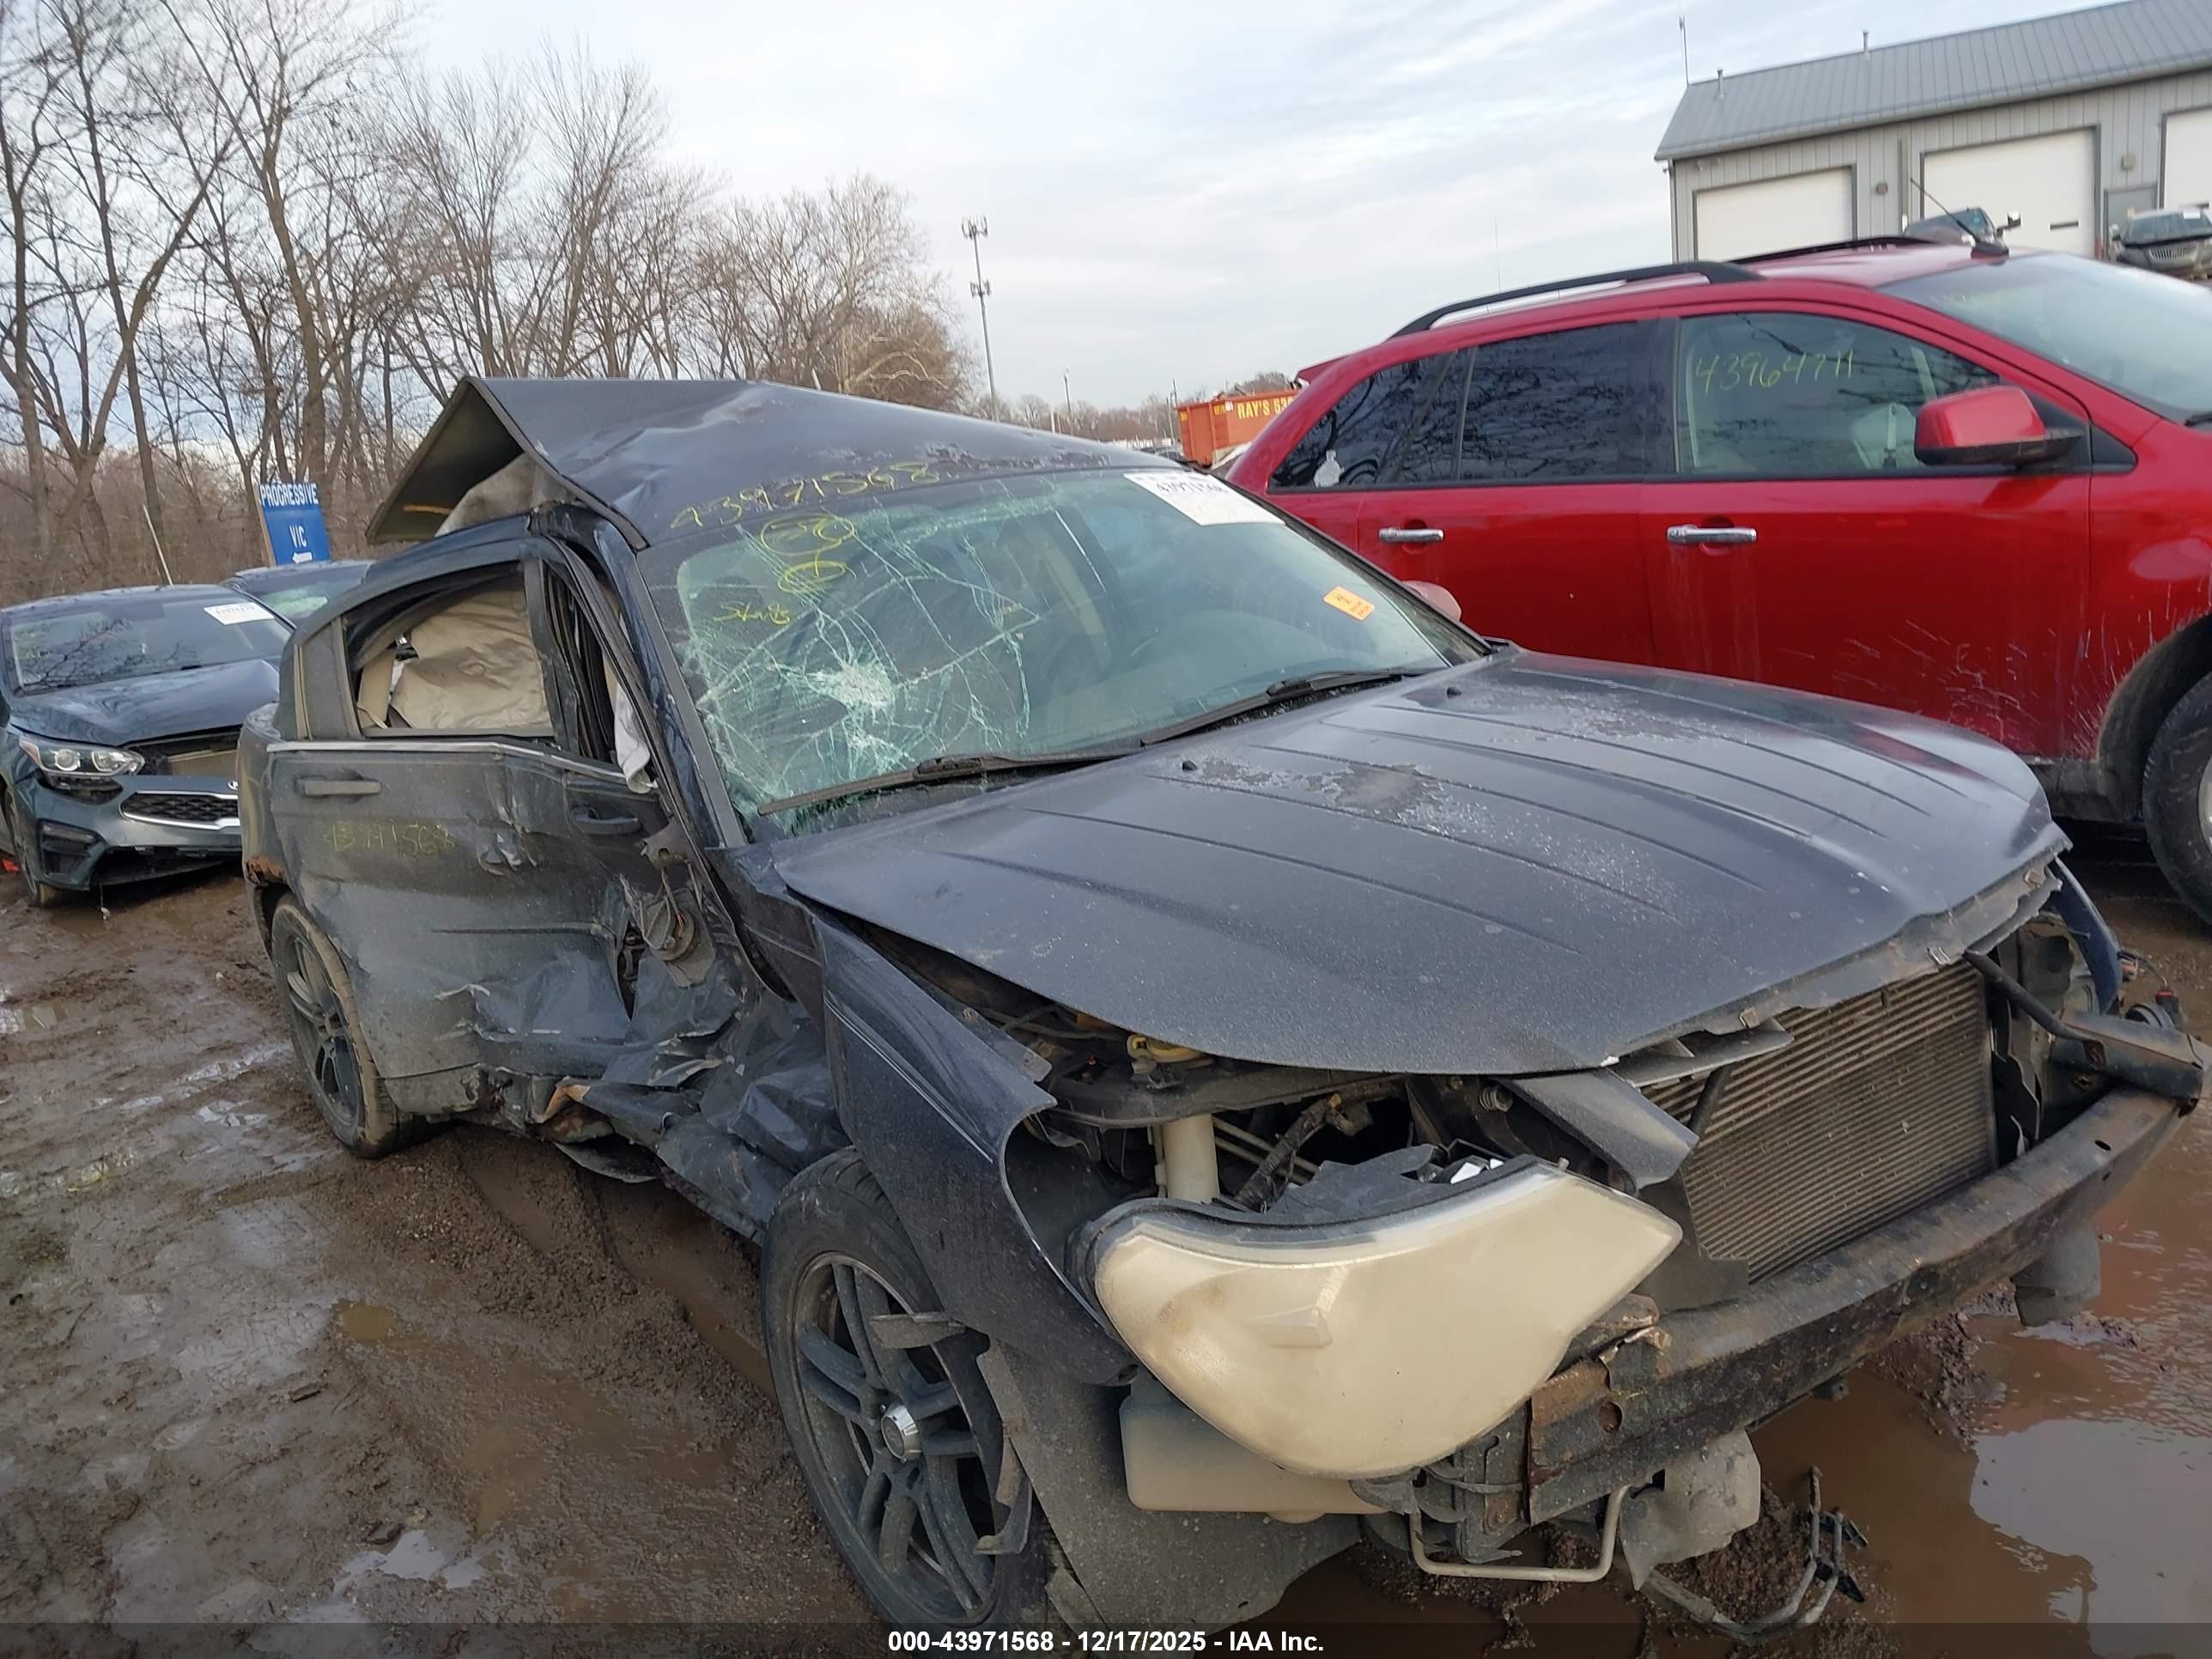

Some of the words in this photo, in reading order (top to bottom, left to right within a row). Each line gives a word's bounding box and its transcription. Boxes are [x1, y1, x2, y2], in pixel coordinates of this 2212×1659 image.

[1696, 349, 1855, 397] 43964711
[1237, 402, 1270, 419] RAY'S
[260, 483, 319, 507] PROGRESSIVE
[289, 525, 307, 548] VIC
